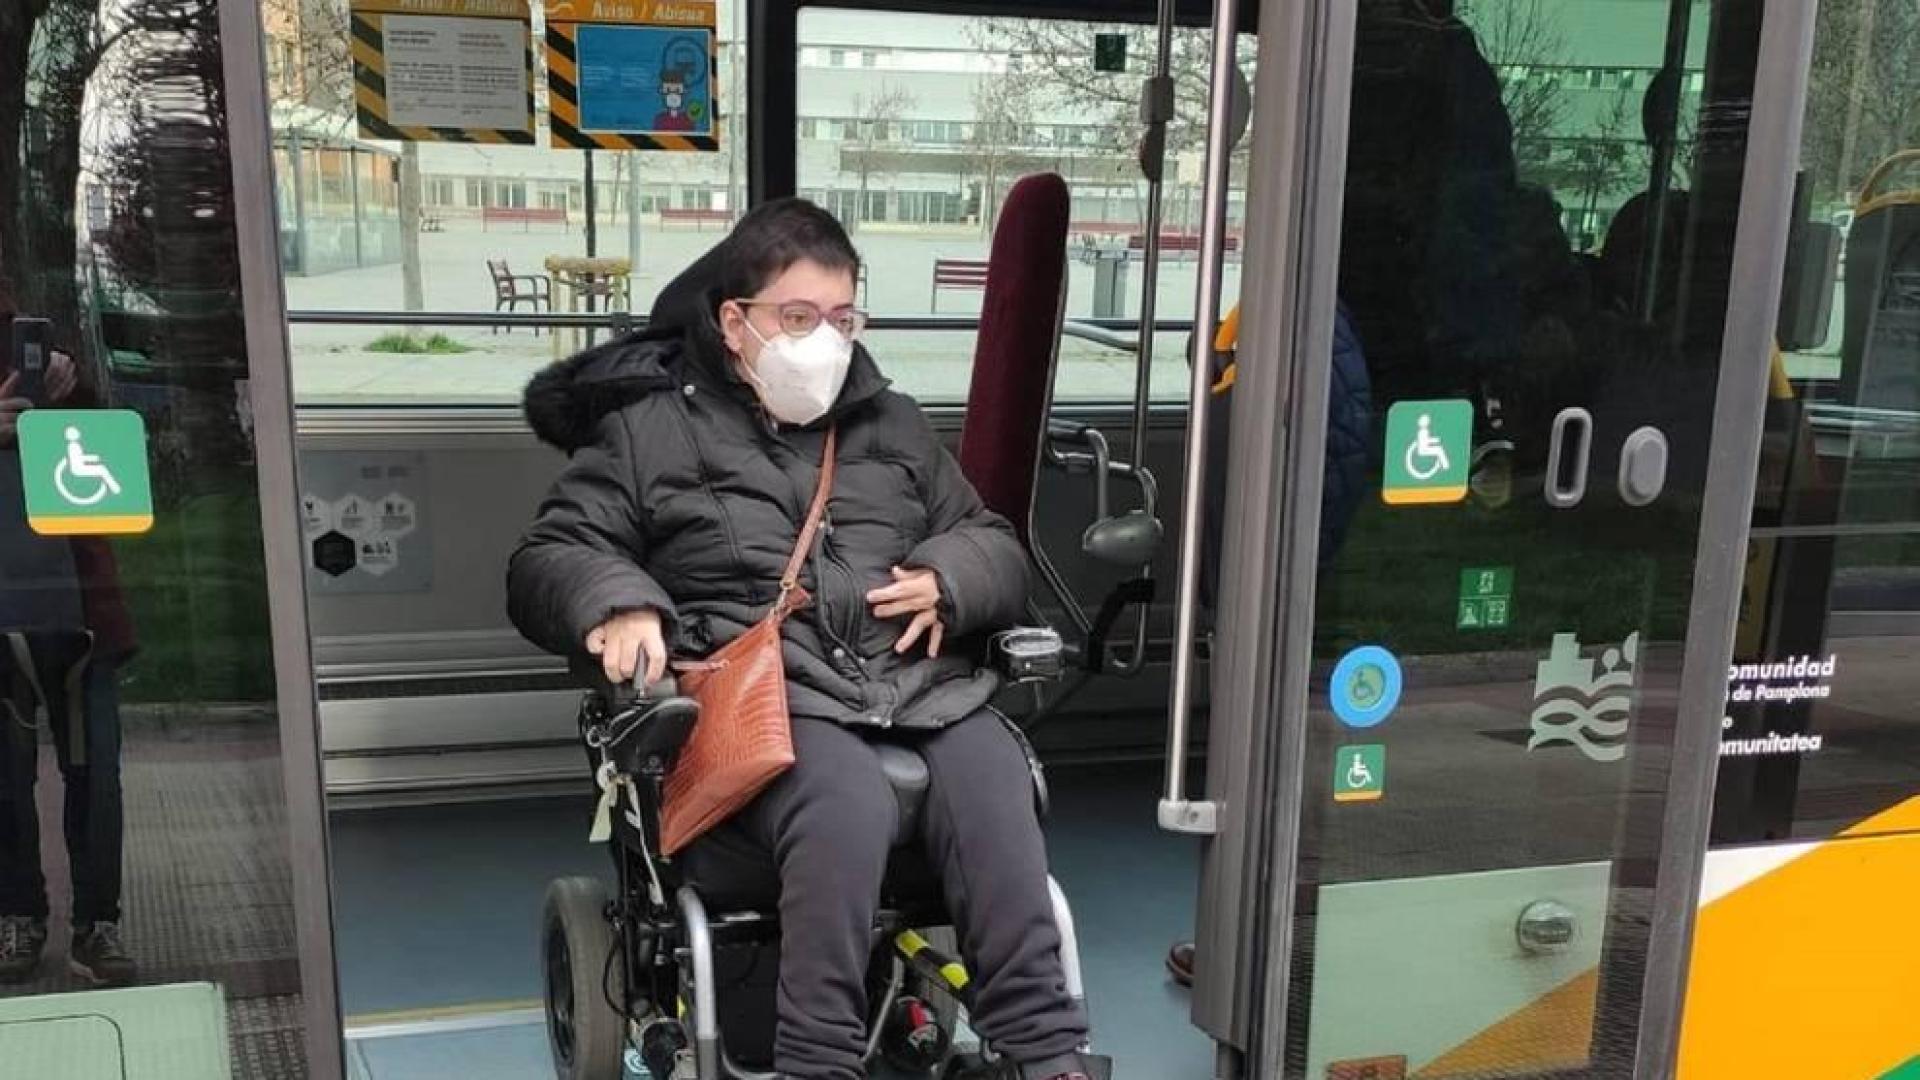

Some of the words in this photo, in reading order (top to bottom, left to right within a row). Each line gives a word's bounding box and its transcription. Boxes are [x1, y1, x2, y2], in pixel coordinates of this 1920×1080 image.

[592, 1, 634, 18] Aviso
[1733, 683, 1752, 701] de
[1755, 681, 1831, 704] Pamplona
